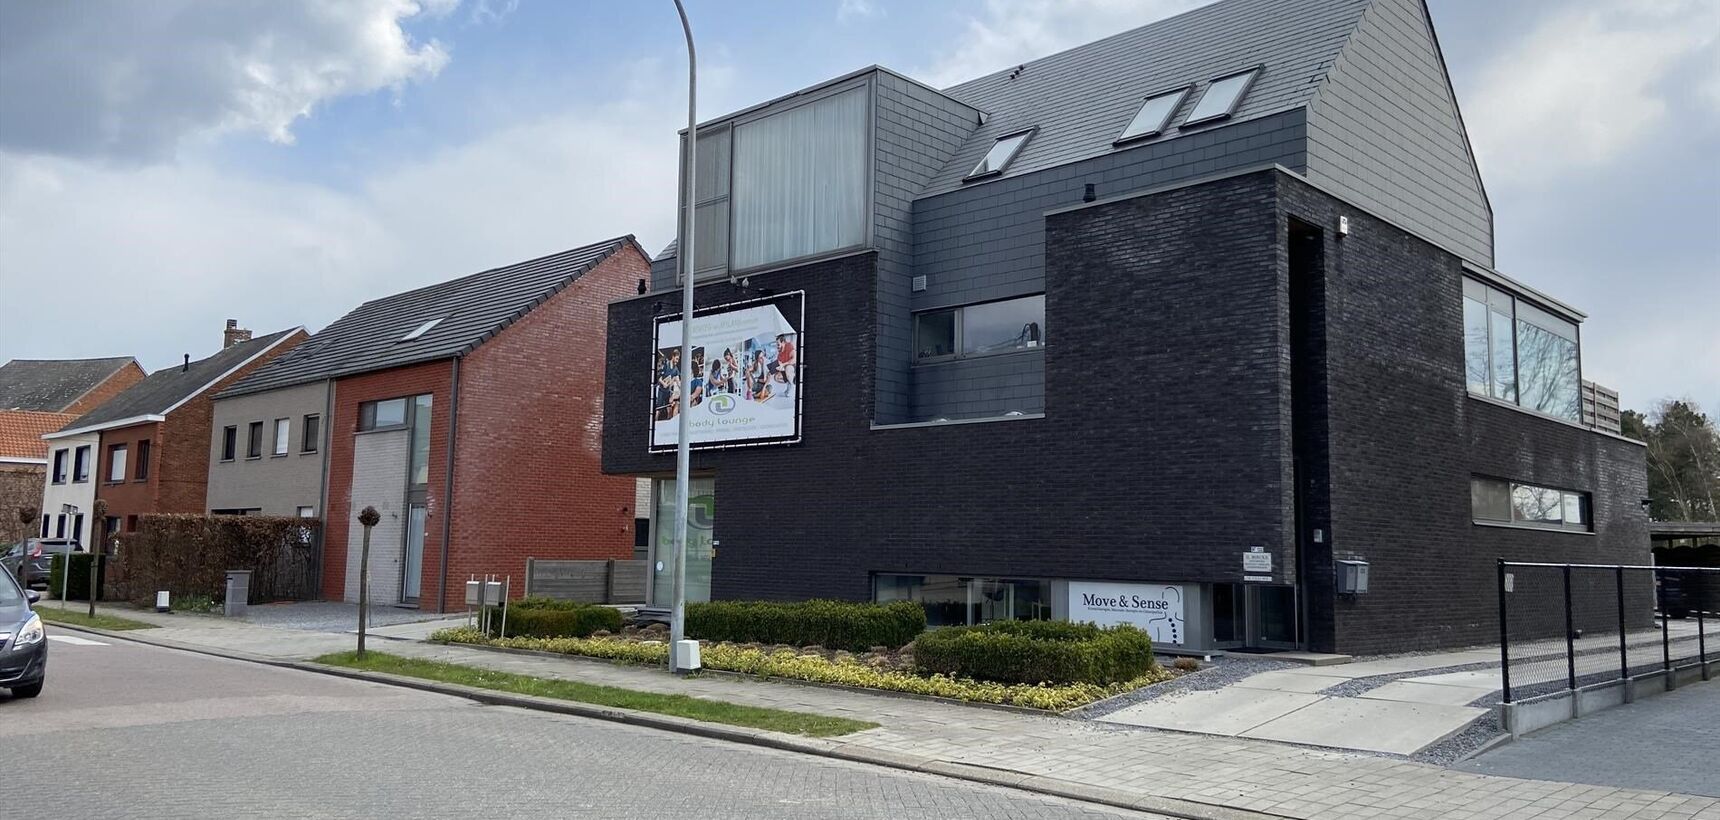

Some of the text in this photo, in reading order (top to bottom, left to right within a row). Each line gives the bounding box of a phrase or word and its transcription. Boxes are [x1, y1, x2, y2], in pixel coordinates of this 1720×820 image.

[689, 419, 714, 427] body
[1082, 593, 1169, 610] Move & Sense
